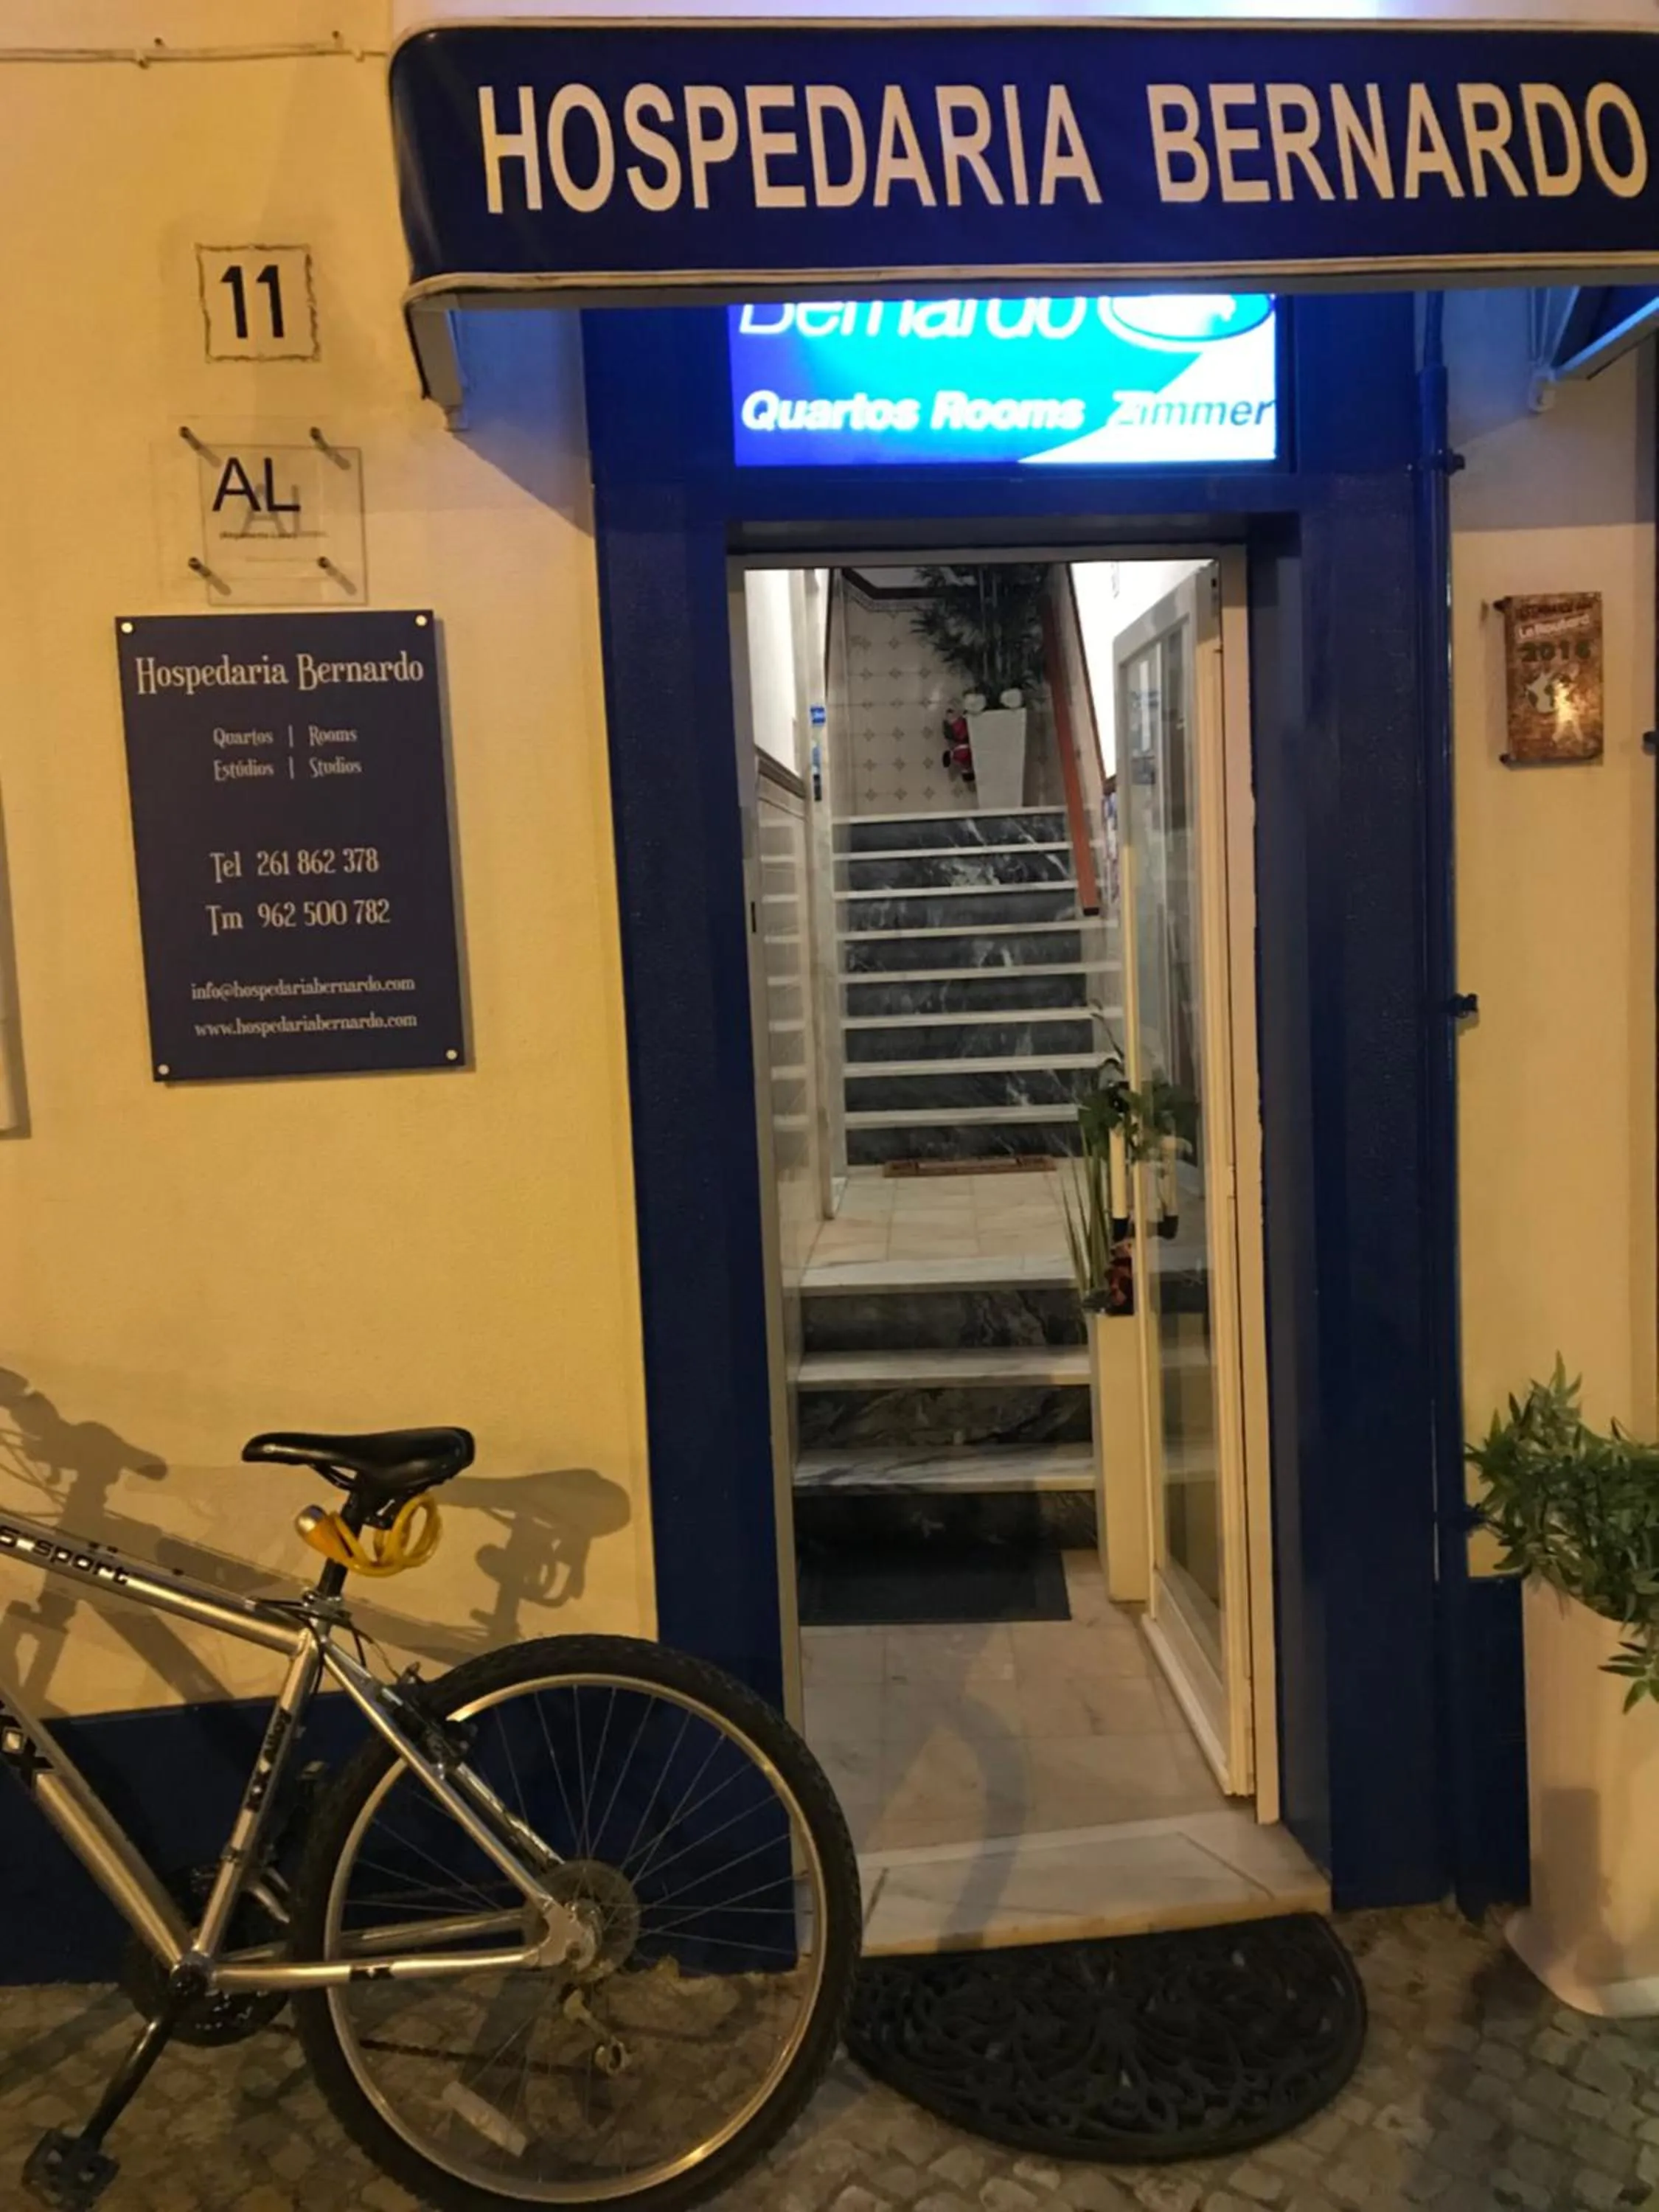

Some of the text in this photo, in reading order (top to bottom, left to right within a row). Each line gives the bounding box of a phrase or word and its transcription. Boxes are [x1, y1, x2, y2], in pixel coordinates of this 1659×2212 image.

[478, 81, 1649, 214] HOSPEDARIA BERNARDO
[220, 265, 284, 338] 11
[740, 389, 1276, 431] Quartos Rooms Zimmer
[212, 457, 301, 512] AL
[136, 651, 424, 695] Hospedaria Bernardo
[212, 727, 274, 748] Quartos
[308, 724, 358, 747] Rooms
[213, 758, 274, 782] Estúdios
[309, 756, 362, 778] Studios
[210, 848, 379, 883] Tel 261 862 378
[205, 899, 390, 936] Tm 962 500 782
[191, 975, 415, 1001] info@hospedariabernardo.com
[195, 1011, 417, 1037] www.hospedariabernardo.com
